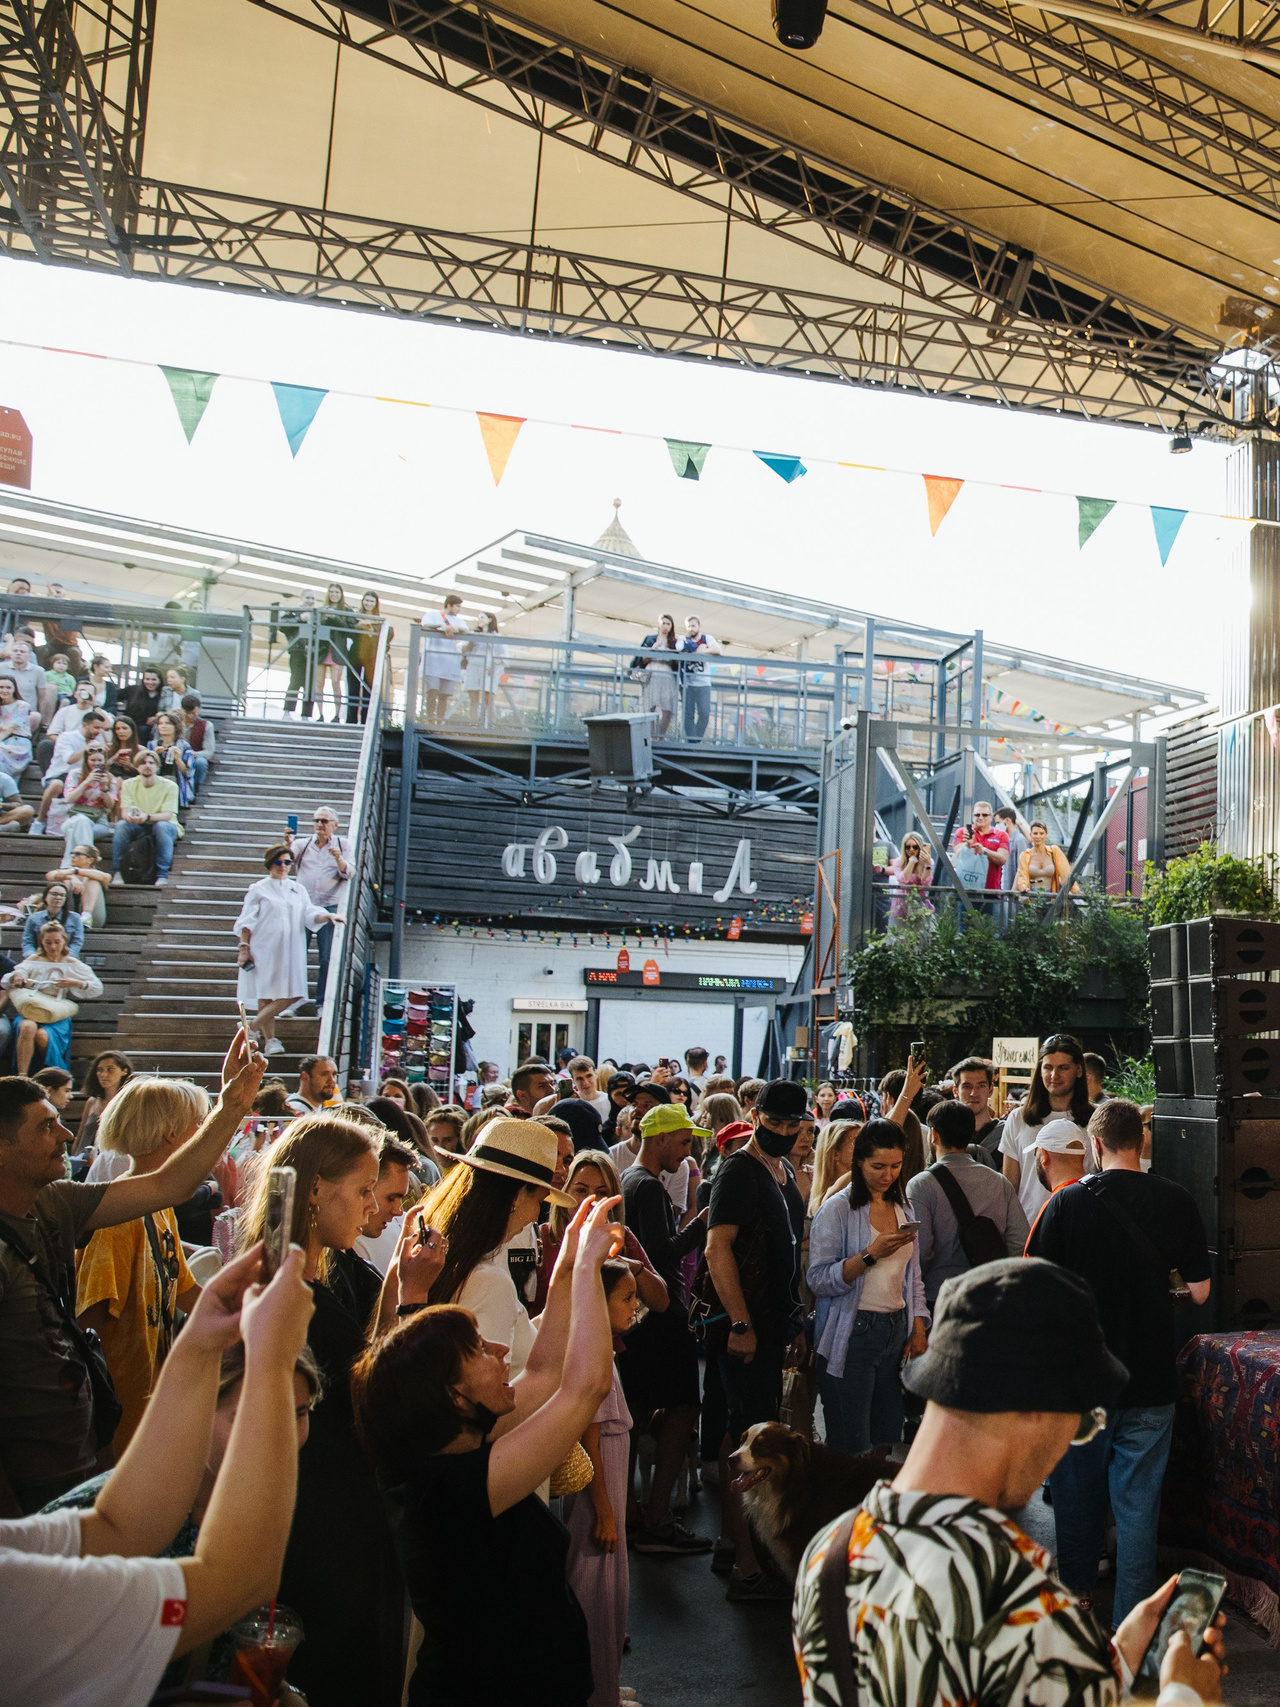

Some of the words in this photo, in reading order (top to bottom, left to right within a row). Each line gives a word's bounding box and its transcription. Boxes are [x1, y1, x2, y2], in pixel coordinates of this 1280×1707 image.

[528, 1000, 557, 1009] STRELKA
[560, 1001, 574, 1009] BAR
[510, 1255, 524, 1263] BIG
